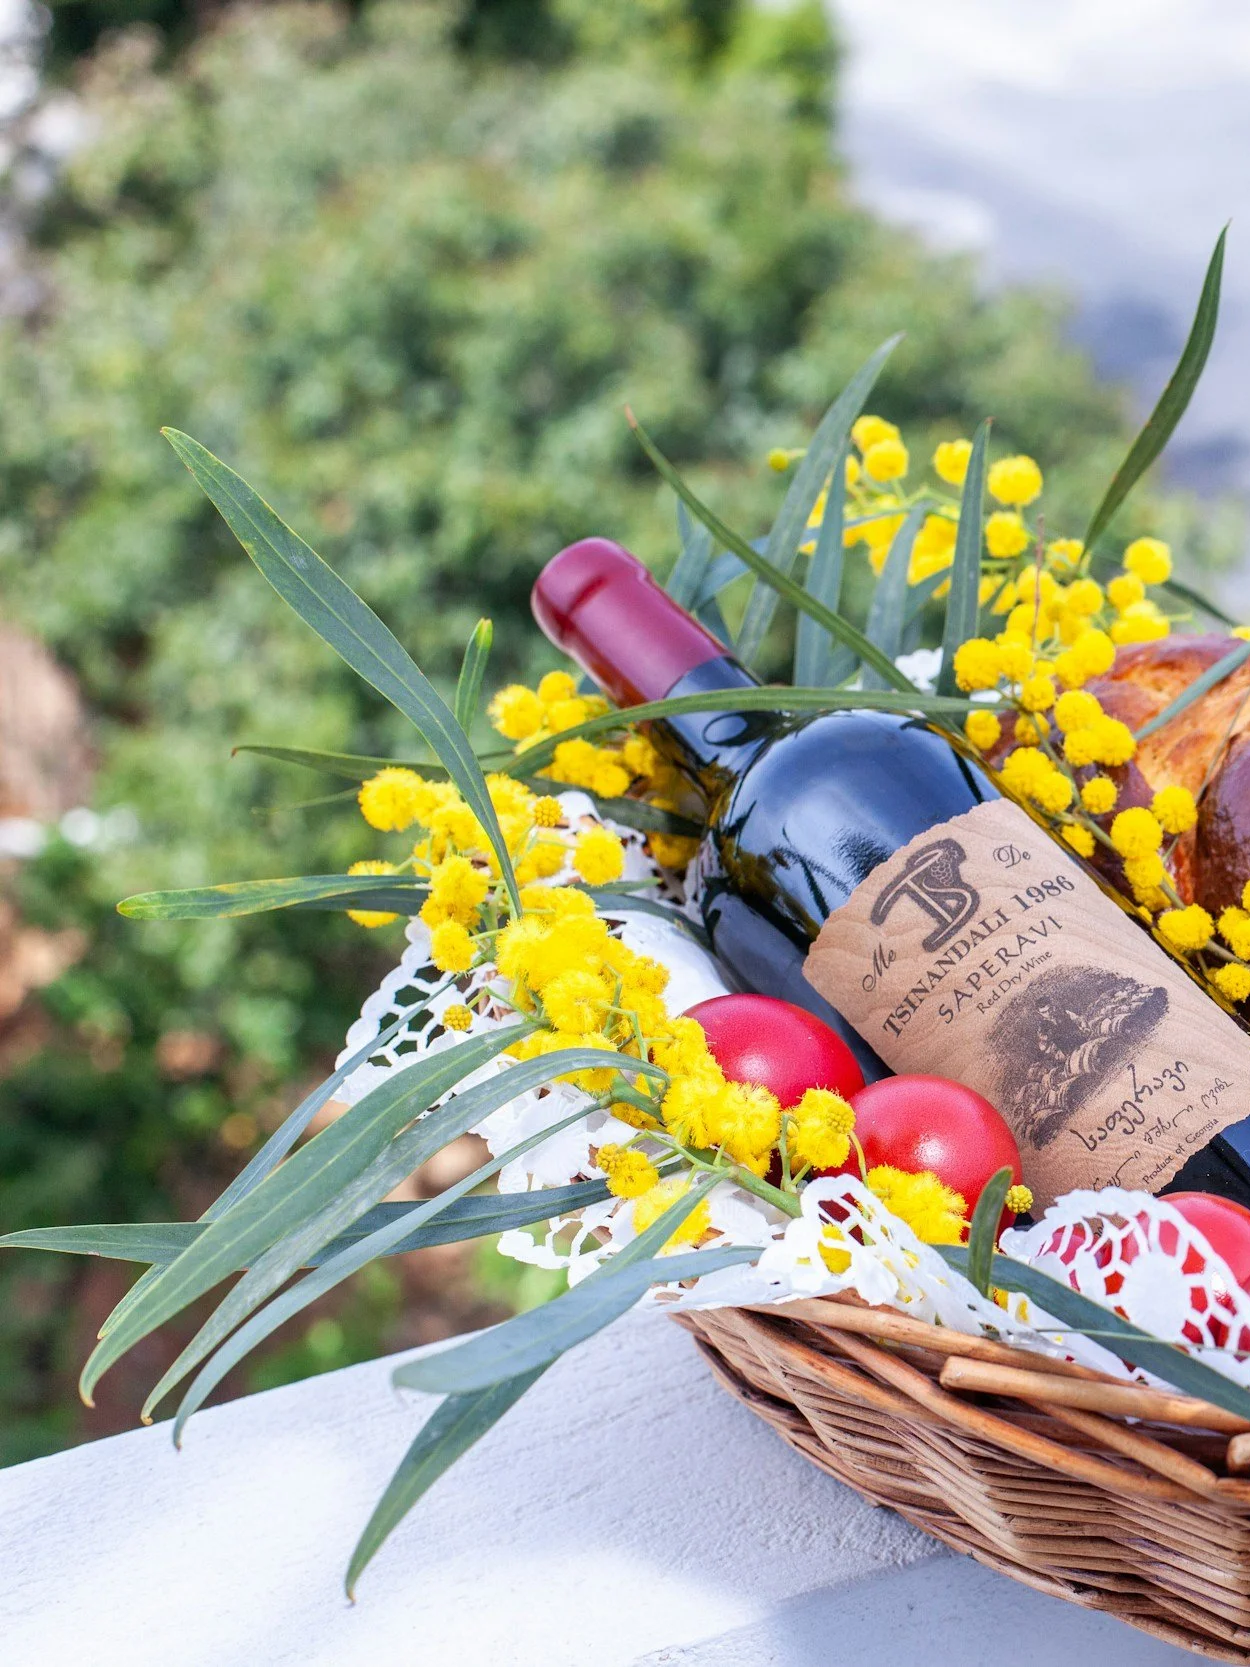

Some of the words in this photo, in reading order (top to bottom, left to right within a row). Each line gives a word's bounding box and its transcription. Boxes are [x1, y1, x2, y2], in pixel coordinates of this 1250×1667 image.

[861, 942, 896, 992] Me
[992, 844, 1031, 868] De
[882, 907, 1011, 1038] TSINANDALI
[1010, 875, 1075, 912] 1986
[938, 915, 1063, 1024] SAPERAVI
[976, 990, 1000, 1014] Red
[999, 972, 1022, 994] Dry
[1021, 950, 1052, 973] Wine
[1142, 1155, 1174, 1185] Product
[1175, 1144, 1185, 1155] of
[1185, 1118, 1219, 1145] Georgia
